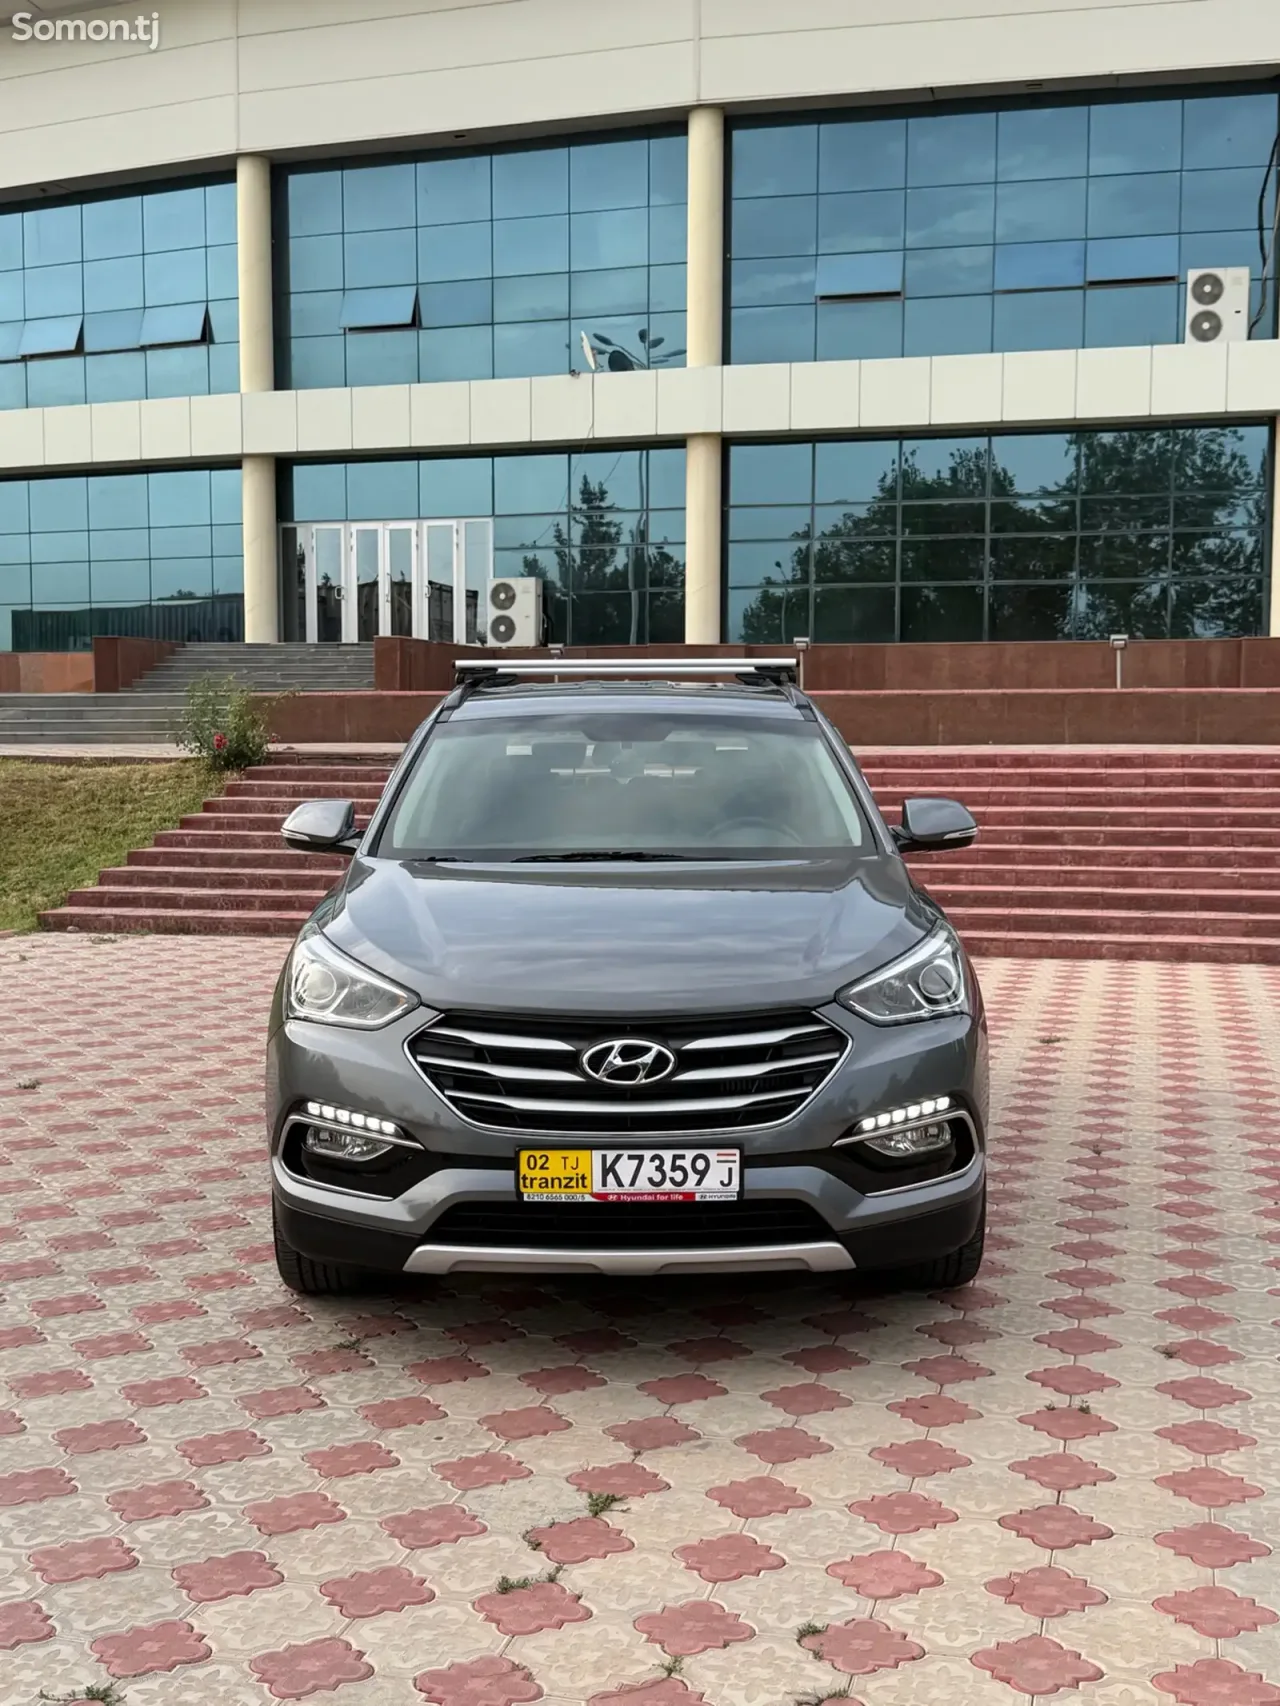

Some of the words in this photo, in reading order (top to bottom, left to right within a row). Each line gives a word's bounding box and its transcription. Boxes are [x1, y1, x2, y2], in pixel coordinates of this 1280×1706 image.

[526, 1154, 549, 1170] 02
[561, 1156, 579, 1170] TJ
[601, 1153, 711, 1188] K7359
[719, 1167, 733, 1187] J
[521, 1173, 588, 1189] tranzit
[620, 1192, 654, 1202] Hyundai
[656, 1192, 668, 1200] for
[670, 1192, 684, 1200] life
